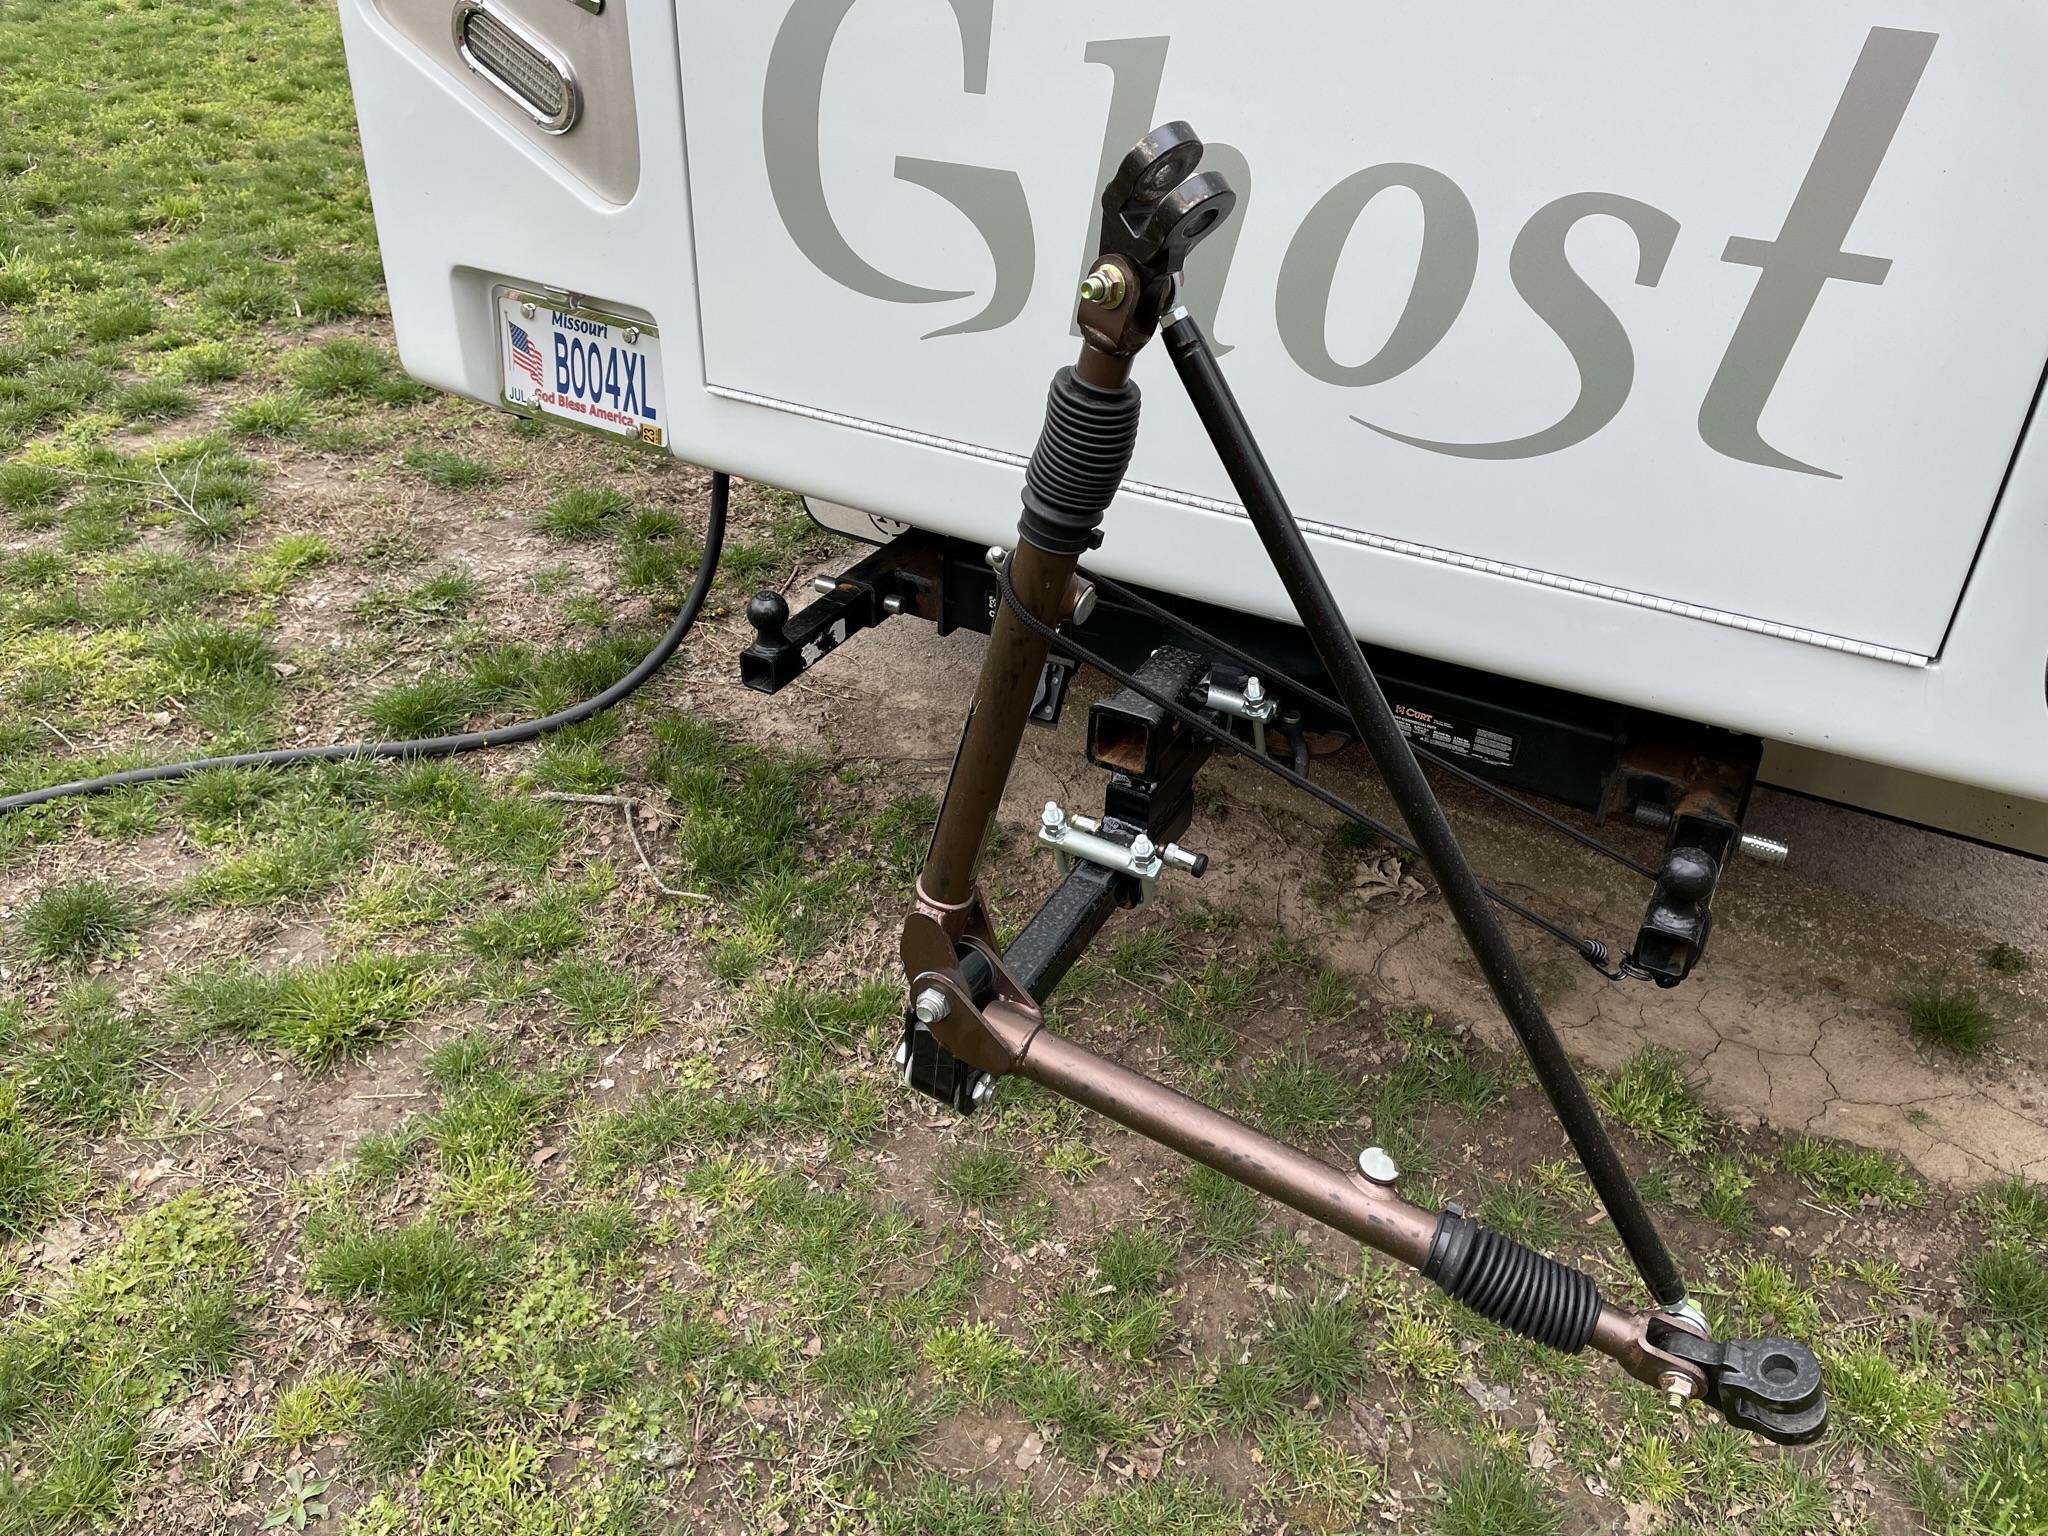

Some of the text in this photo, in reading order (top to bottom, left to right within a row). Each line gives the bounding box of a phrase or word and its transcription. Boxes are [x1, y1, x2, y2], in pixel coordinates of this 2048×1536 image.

[762, 0, 1939, 480] Ghost
[552, 310, 608, 339] Missouri
[509, 386, 527, 403] JUL
[534, 388, 634, 427] God Bless America
[643, 428, 655, 443] 23
